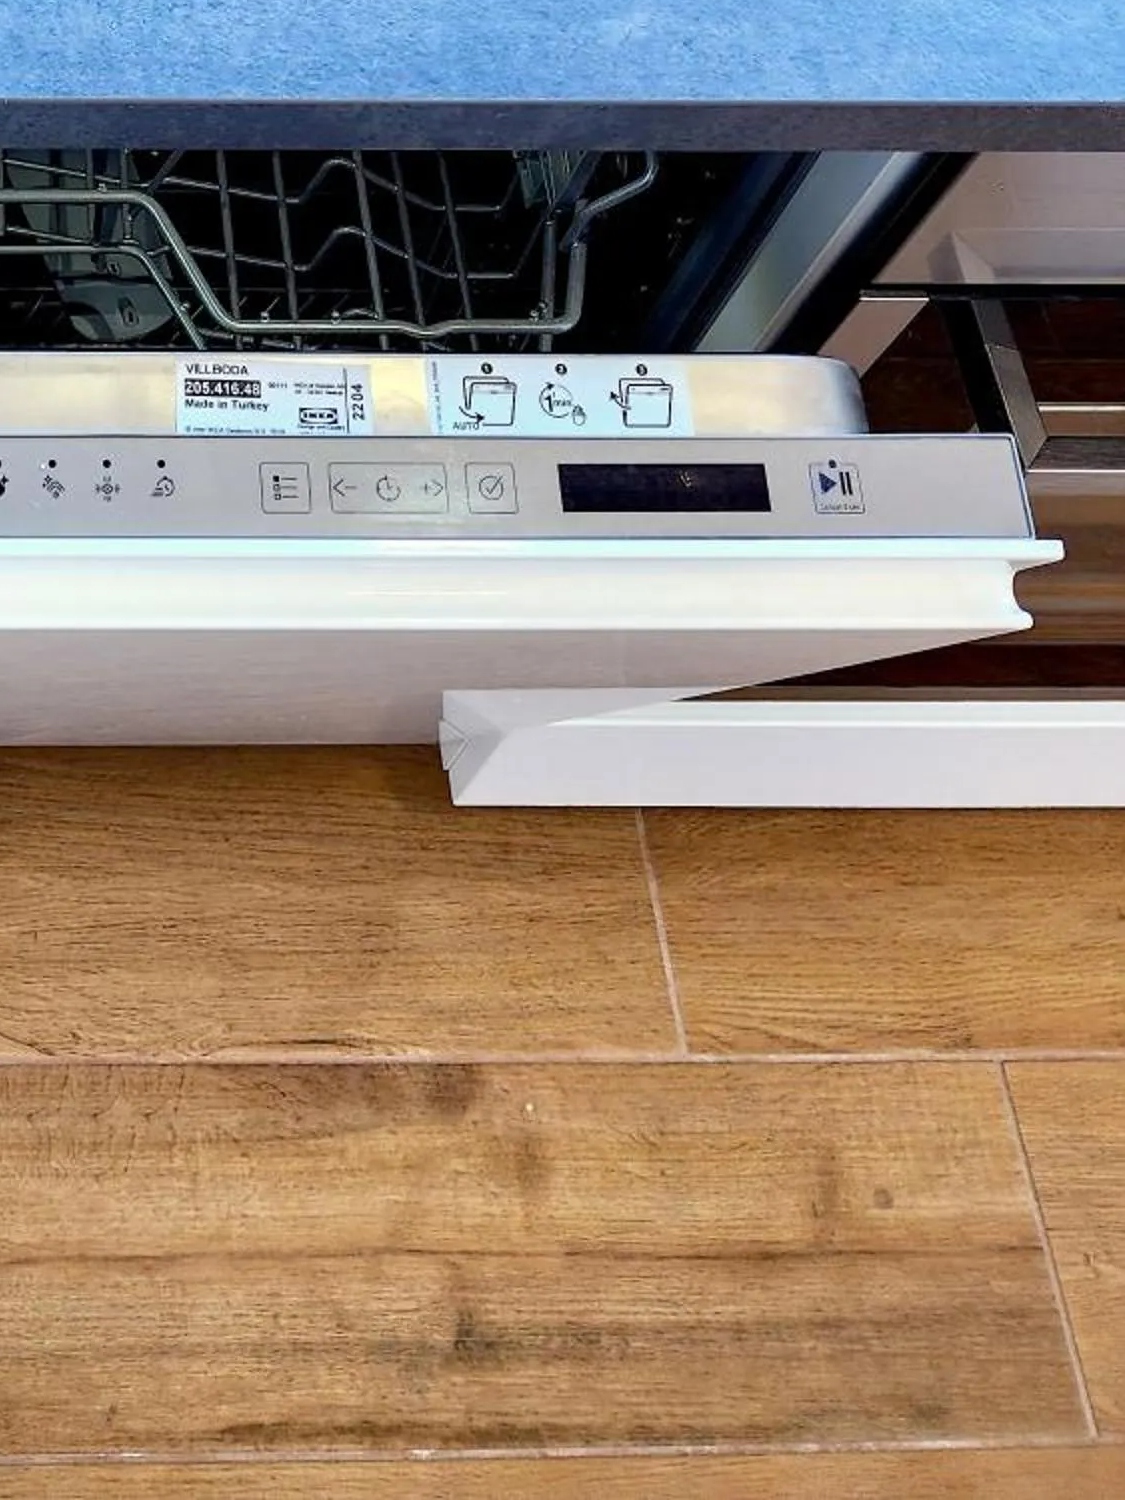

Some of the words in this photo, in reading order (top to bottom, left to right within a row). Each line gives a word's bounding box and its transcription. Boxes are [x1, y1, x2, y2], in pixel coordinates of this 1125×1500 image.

[185, 380, 261, 397] 205.416.48
[185, 399, 214, 409] Made
[217, 399, 228, 409] in
[230, 399, 270, 412] Turkey
[351, 383, 366, 421] 2204
[452, 421, 480, 431] AUTO
